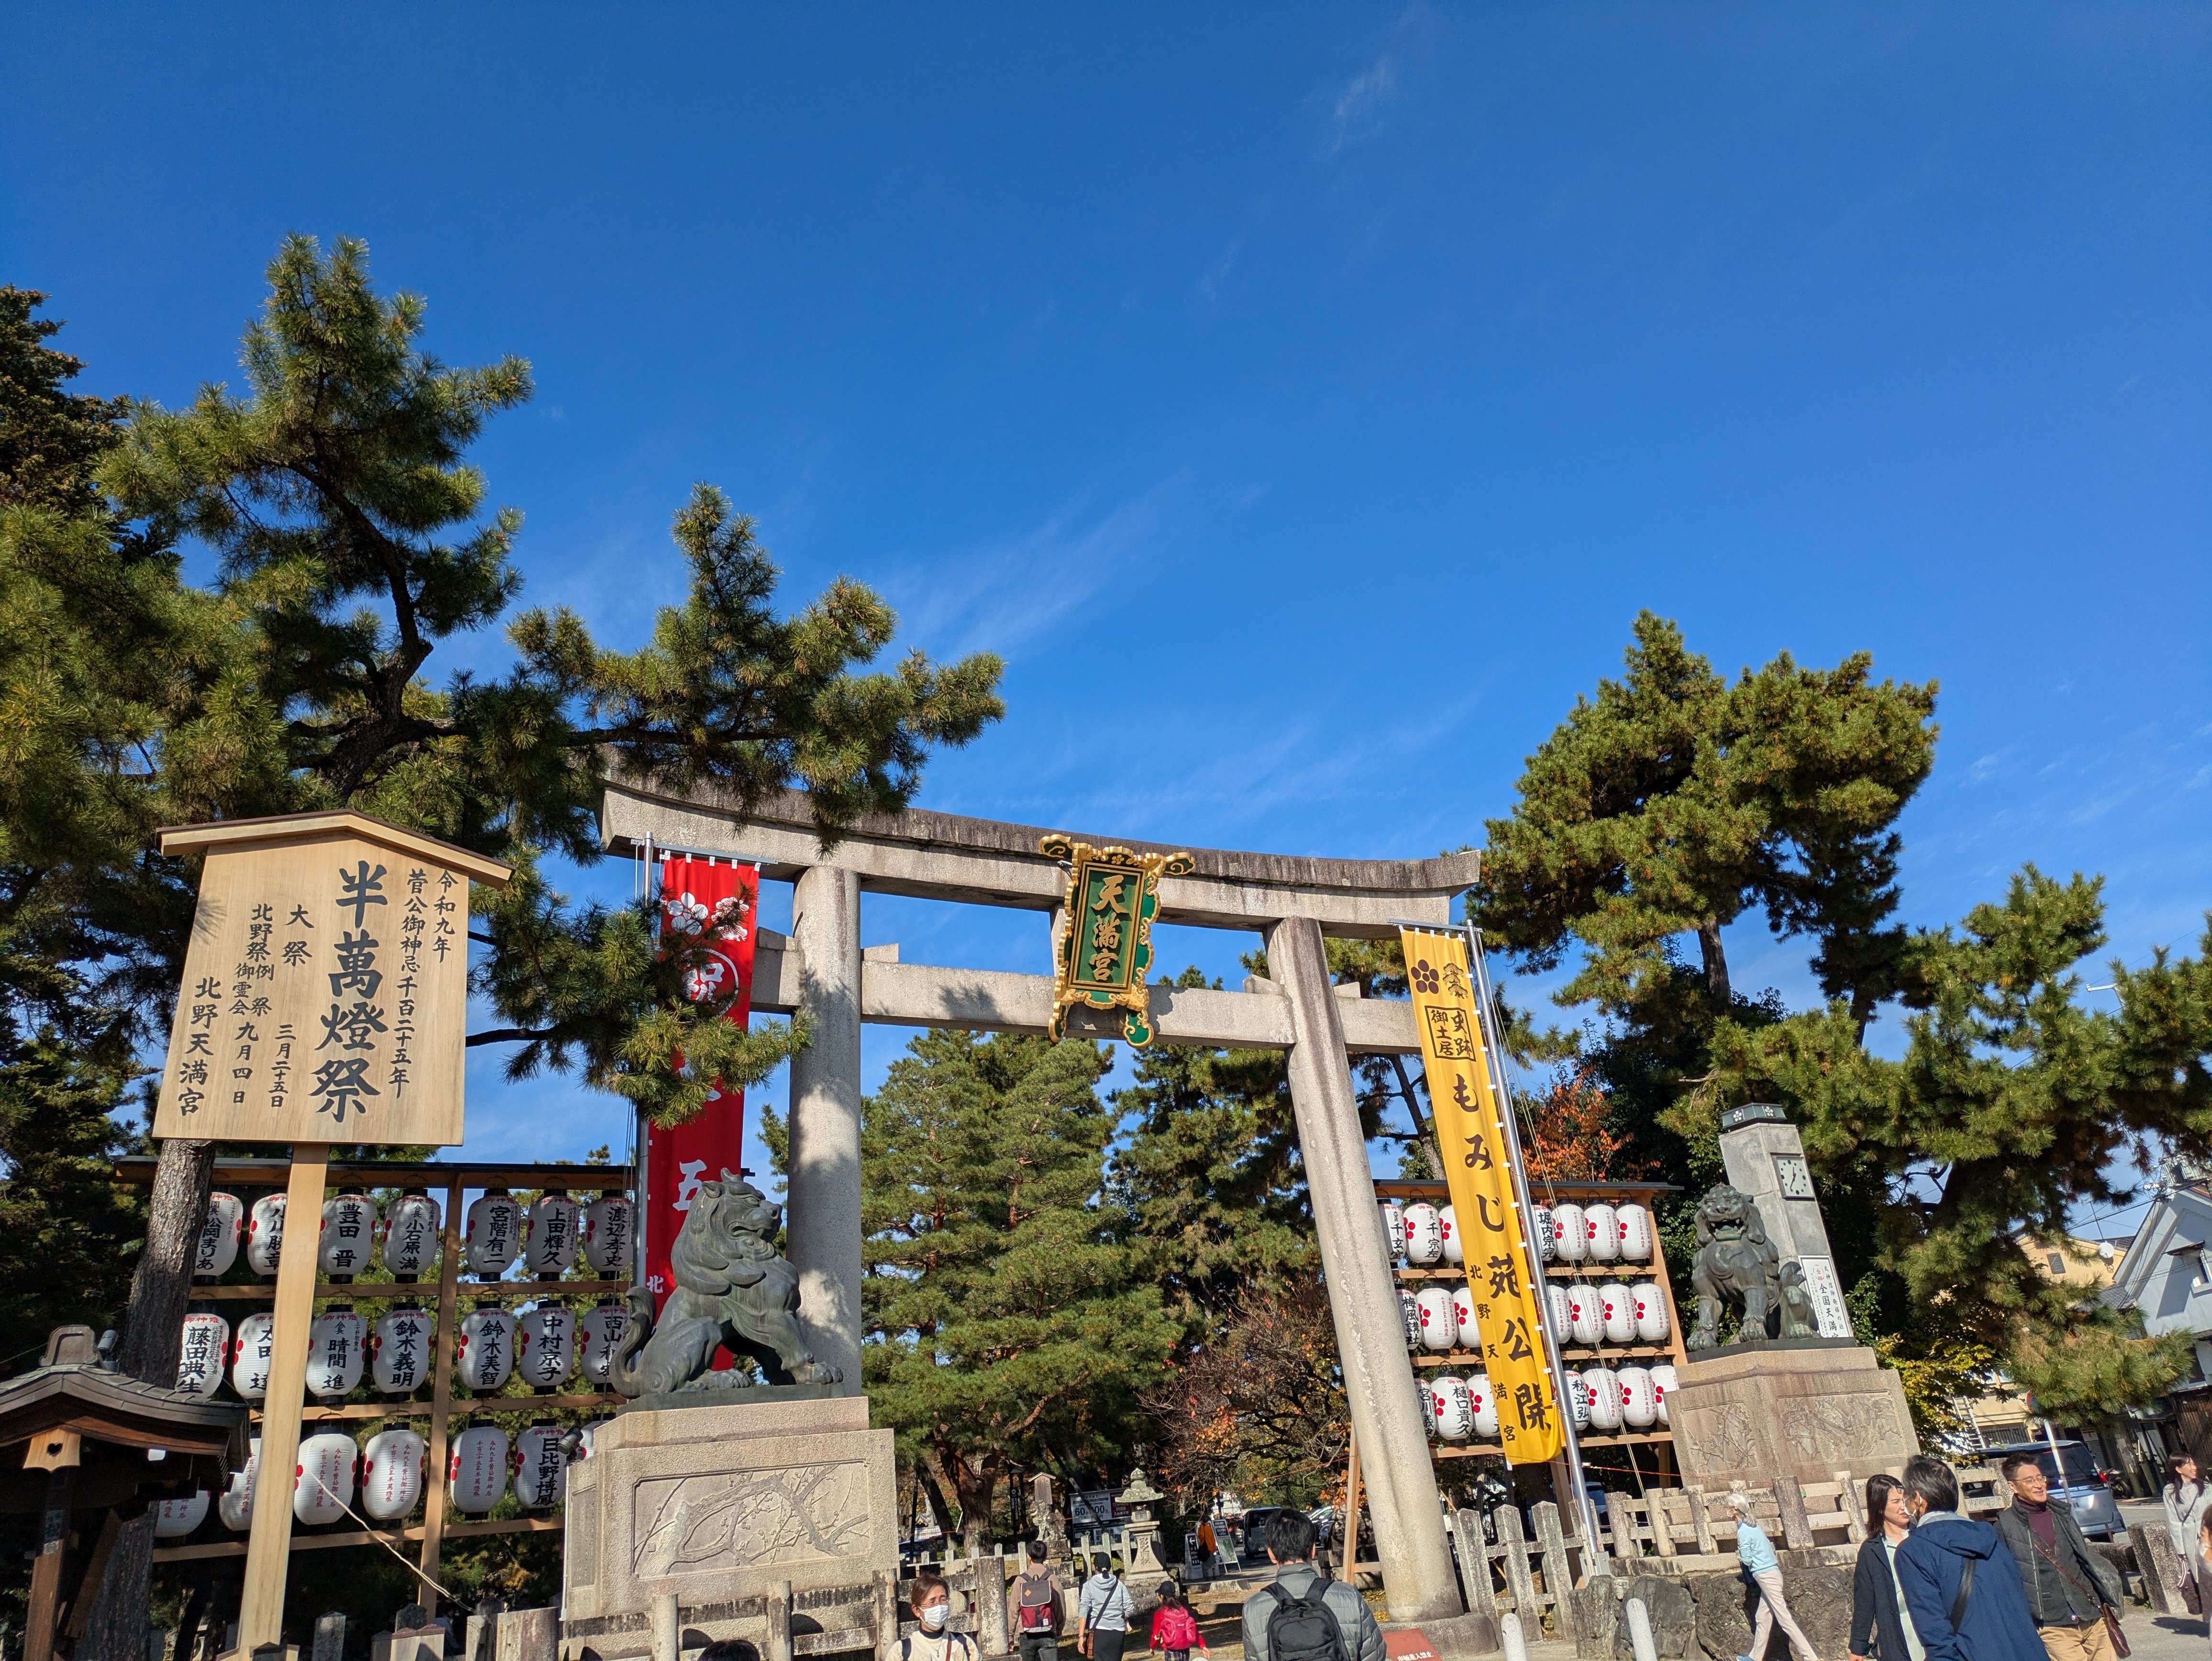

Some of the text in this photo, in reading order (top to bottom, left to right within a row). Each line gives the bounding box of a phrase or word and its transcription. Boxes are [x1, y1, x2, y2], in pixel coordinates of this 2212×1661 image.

[246, 903, 273, 963] 北野祭
[281, 904, 315, 966] 大祭
[431, 870, 459, 963] 令和九年
[1090, 875, 1129, 981] 天満宮
[308, 861, 388, 1123] 半萬燈祭
[388, 869, 428, 1098] 菅公御神忌千百二十五年
[178, 976, 222, 1116] 北野天満宮
[232, 1021, 259, 1104] 九月四日
[1431, 1009, 1454, 1056] 御土居
[1450, 1010, 1473, 1056] 史跡
[268, 1024, 297, 1108] 三月二十五日
[196, 1218, 224, 1270] 松岡まりあ
[398, 1219, 424, 1270] 小石原満
[483, 1206, 511, 1263] 宮階有二
[540, 1207, 566, 1266] 上田輝久
[1390, 1223, 1404, 1260] 千玄室
[1425, 1222, 1440, 1258] 千宗左
[1428, 1210, 1435, 1220] 家元
[1538, 1212, 1555, 1258] 堀内宗完
[1453, 1073, 1553, 1431] もみじ苑公開
[537, 1316, 564, 1382] 中村京子
[1401, 1296, 1419, 1345] 梅風講社
[177, 1326, 211, 1394] 藤田典生
[389, 1319, 423, 1387] 鈴木義明
[479, 1320, 506, 1385] 鈴木美智
[1470, 1264, 1515, 1442] 北野天満宮
[1452, 1385, 1471, 1435] 樋口貴久
[1571, 1380, 1589, 1423] 秋江弘一
[532, 1437, 560, 1506] 日比野博鳳
